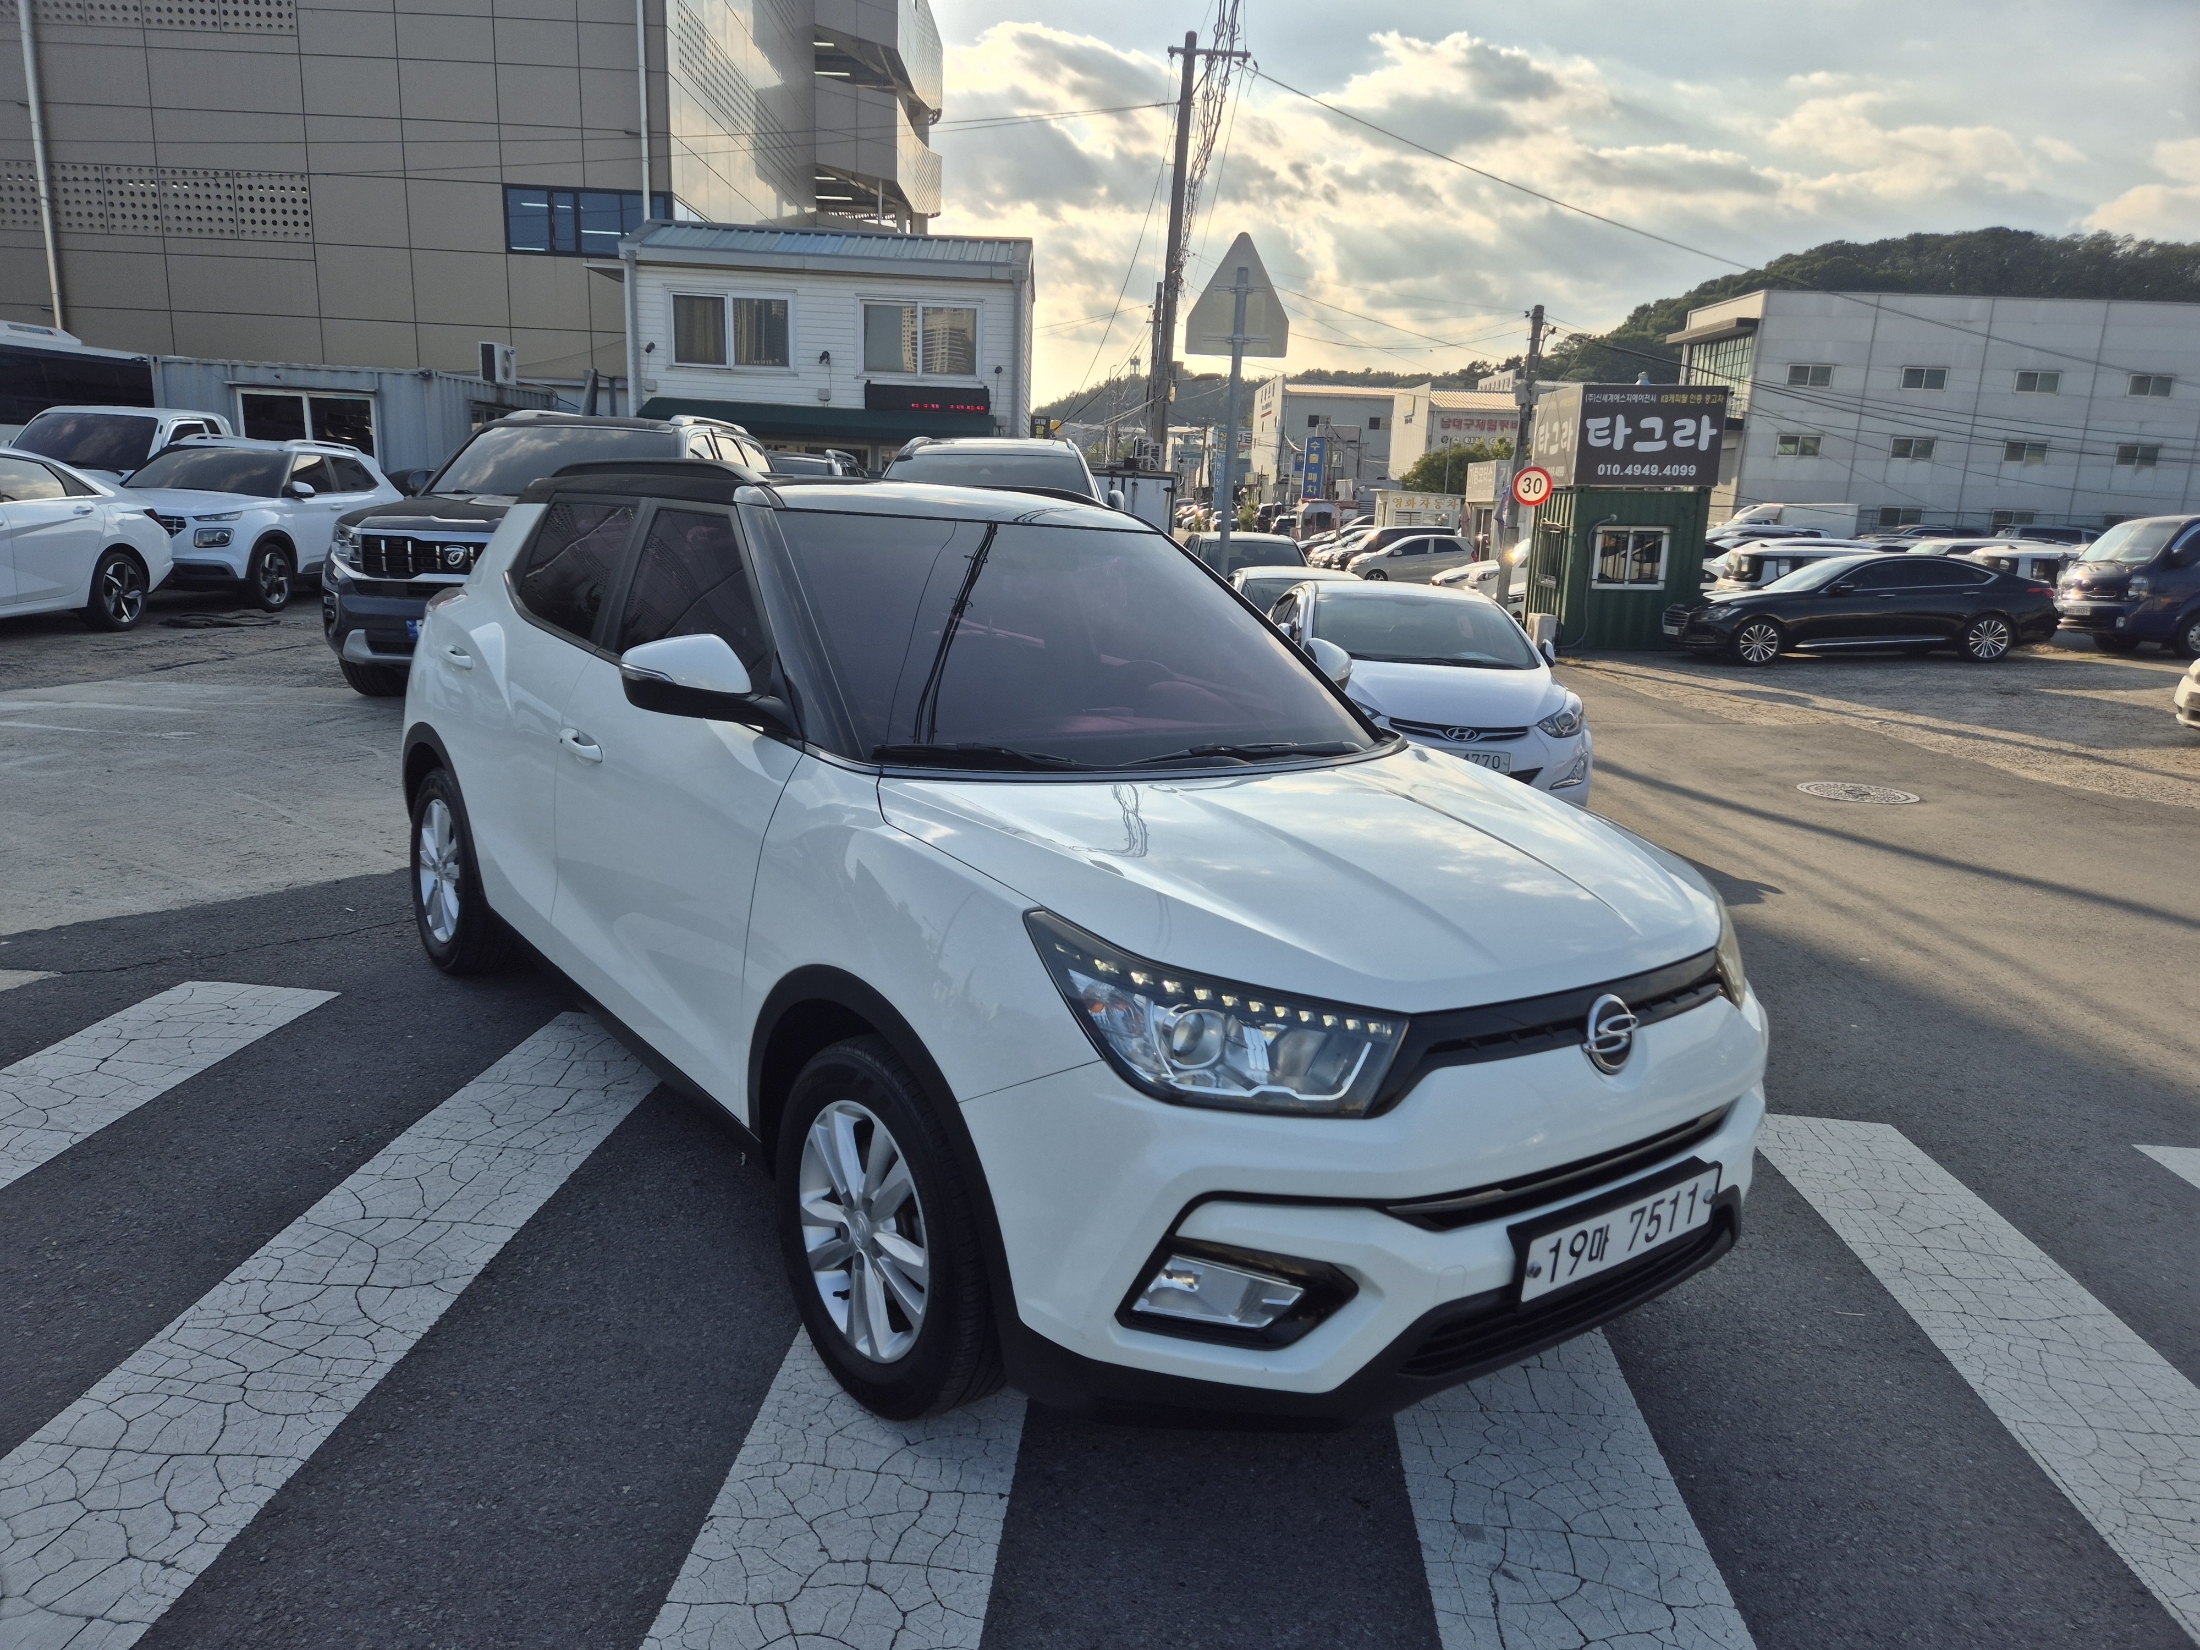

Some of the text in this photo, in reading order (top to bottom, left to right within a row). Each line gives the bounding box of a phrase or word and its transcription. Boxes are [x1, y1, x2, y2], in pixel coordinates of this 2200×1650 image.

[1537, 416, 1574, 455] 타그라
[1585, 414, 1718, 453] 타그라
[1522, 477, 1543, 494] 30
[1597, 464, 1697, 477] 010.4949.4099
[1549, 1182, 1699, 1282] 19마 7511
